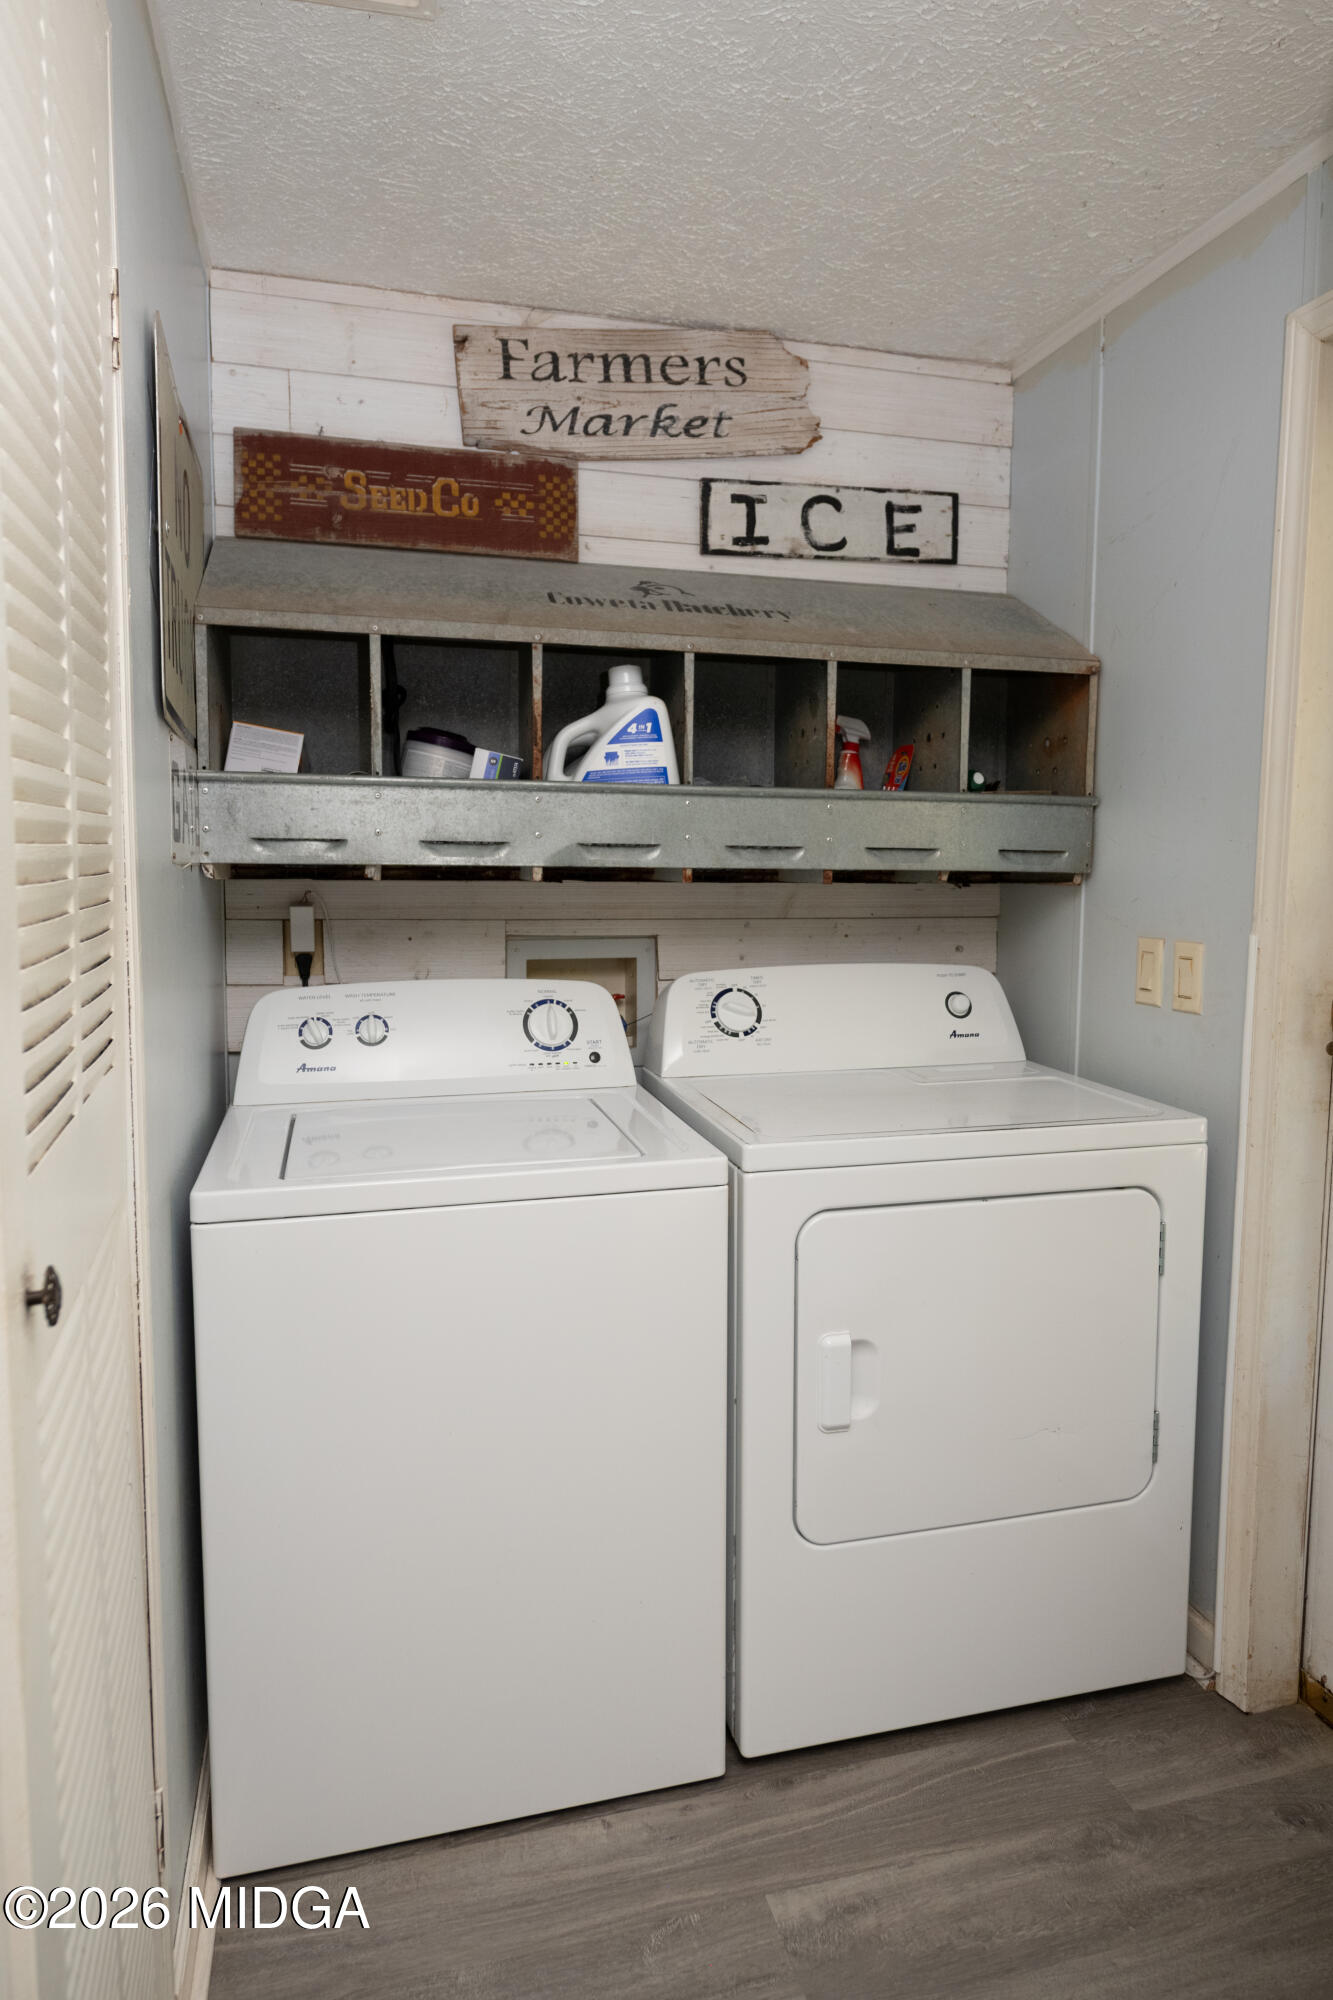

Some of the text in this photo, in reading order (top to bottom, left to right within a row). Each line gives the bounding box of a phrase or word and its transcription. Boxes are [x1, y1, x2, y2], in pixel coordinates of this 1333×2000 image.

[497, 336, 748, 387] Farmers
[520, 403, 734, 440] Market
[730, 493, 923, 558] ICE
[546, 590, 793, 623] Coweta Hatchery
[627, 722, 638, 734] 4
[645, 722, 652, 734] 1
[949, 1030, 980, 1039] Amana
[296, 1062, 337, 1074] Amana
